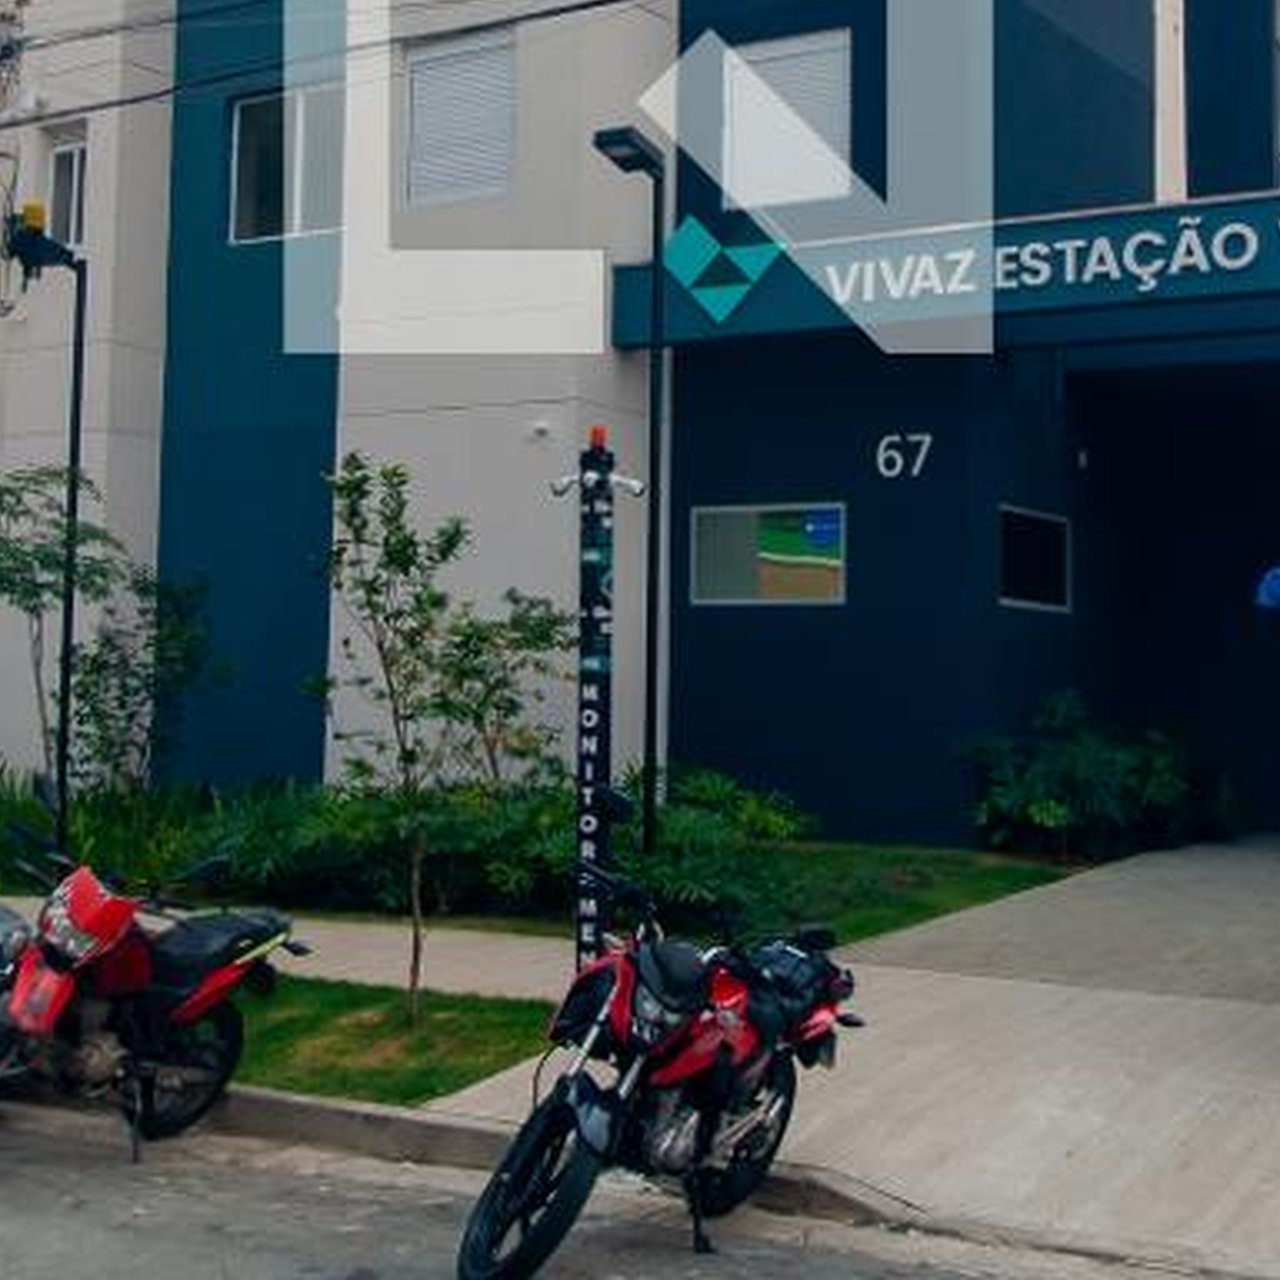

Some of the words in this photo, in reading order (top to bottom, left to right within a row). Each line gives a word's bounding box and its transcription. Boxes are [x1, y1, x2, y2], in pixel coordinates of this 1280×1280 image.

[826, 250, 976, 304] VIVAZ
[994, 216, 1258, 292] ESTAÇÃO
[876, 434, 933, 478] 67
